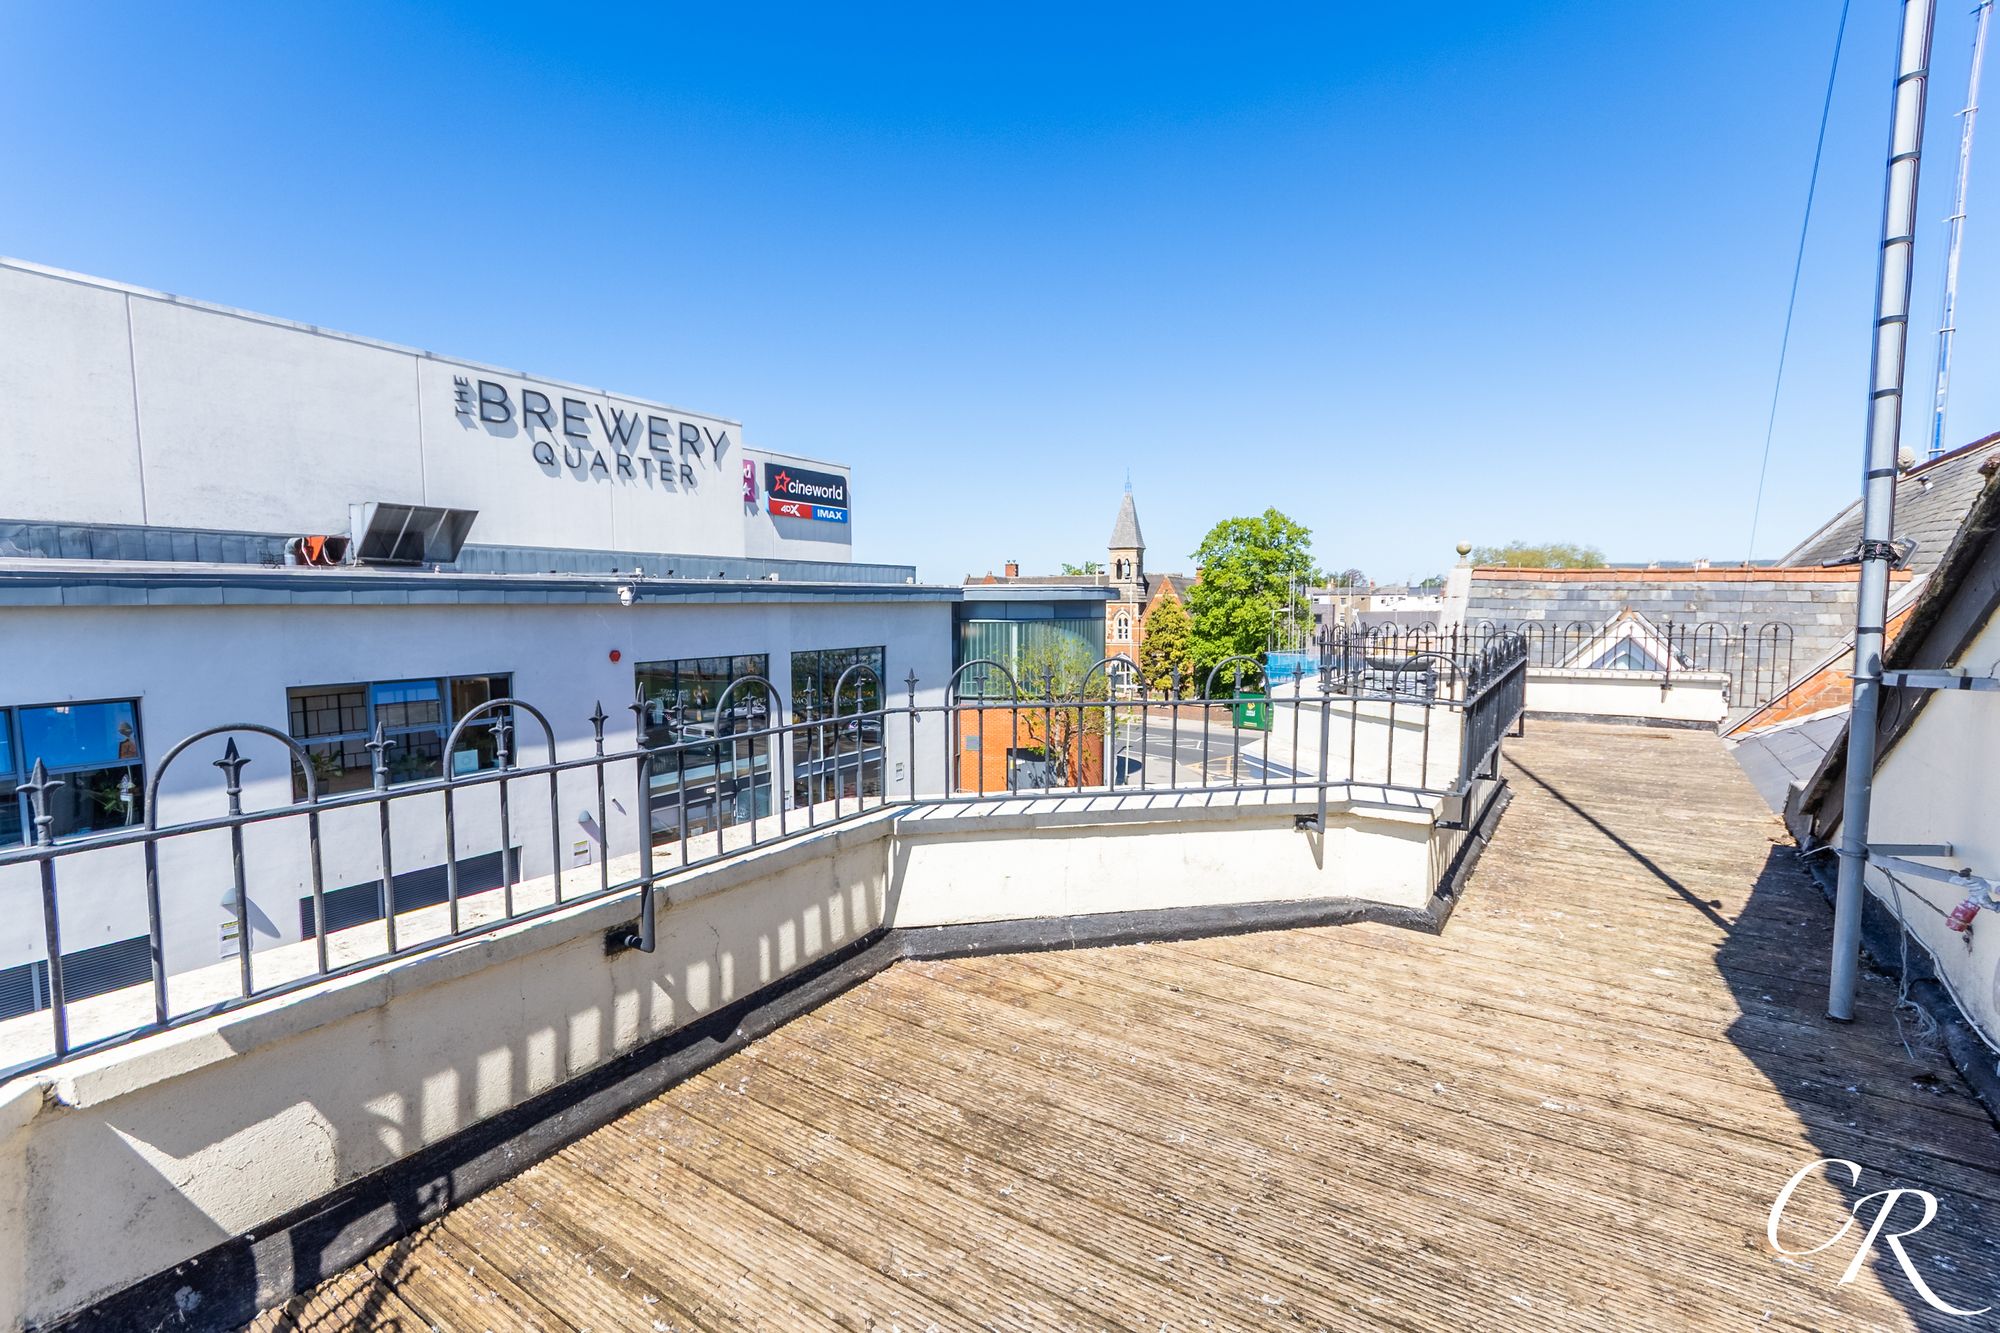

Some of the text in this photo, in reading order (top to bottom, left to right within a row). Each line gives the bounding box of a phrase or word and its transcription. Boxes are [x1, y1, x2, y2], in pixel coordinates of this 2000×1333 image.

[453, 375, 726, 462] THE BREWERY
[533, 441, 693, 485] QUARTER
[788, 480, 843, 500] cineworld
[817, 509, 842, 520] IMAX
